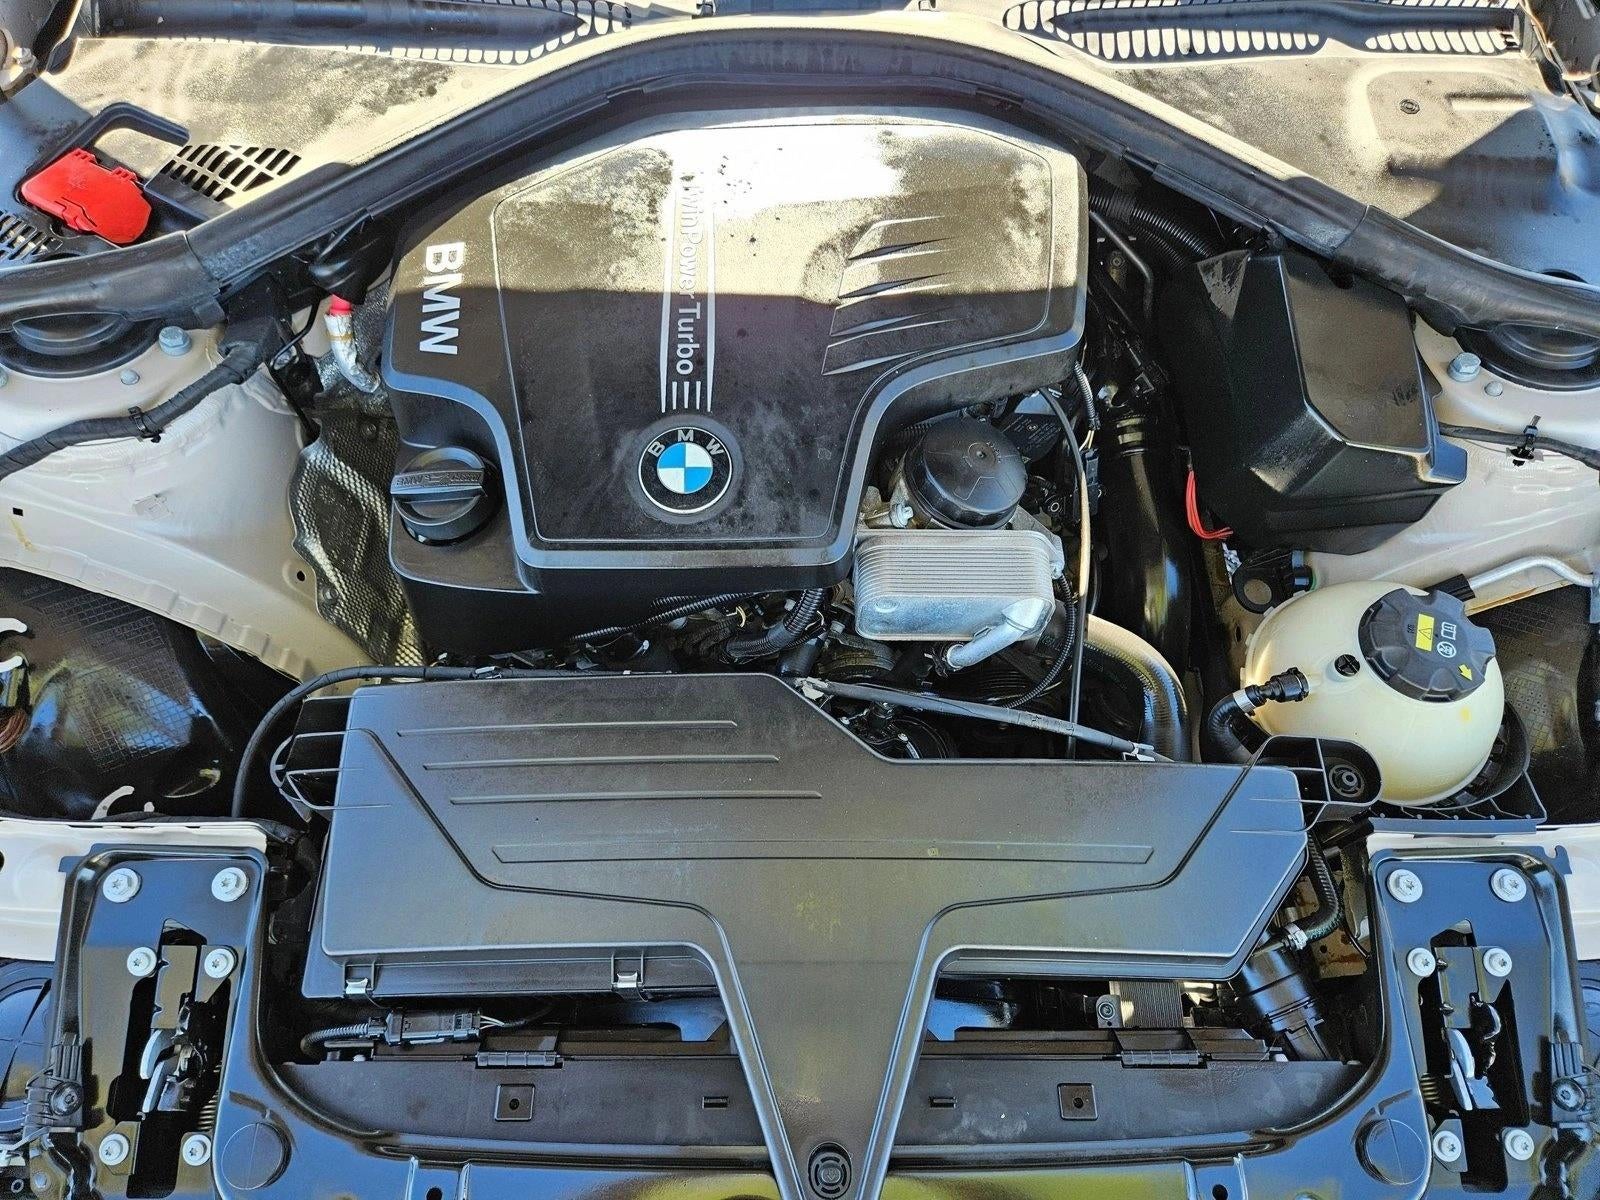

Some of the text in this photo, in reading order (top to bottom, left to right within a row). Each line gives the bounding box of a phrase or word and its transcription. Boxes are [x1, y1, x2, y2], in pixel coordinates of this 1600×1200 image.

[419, 241, 466, 355] BMW
[676, 301, 701, 375] Turbo
[647, 429, 725, 457] BMW
